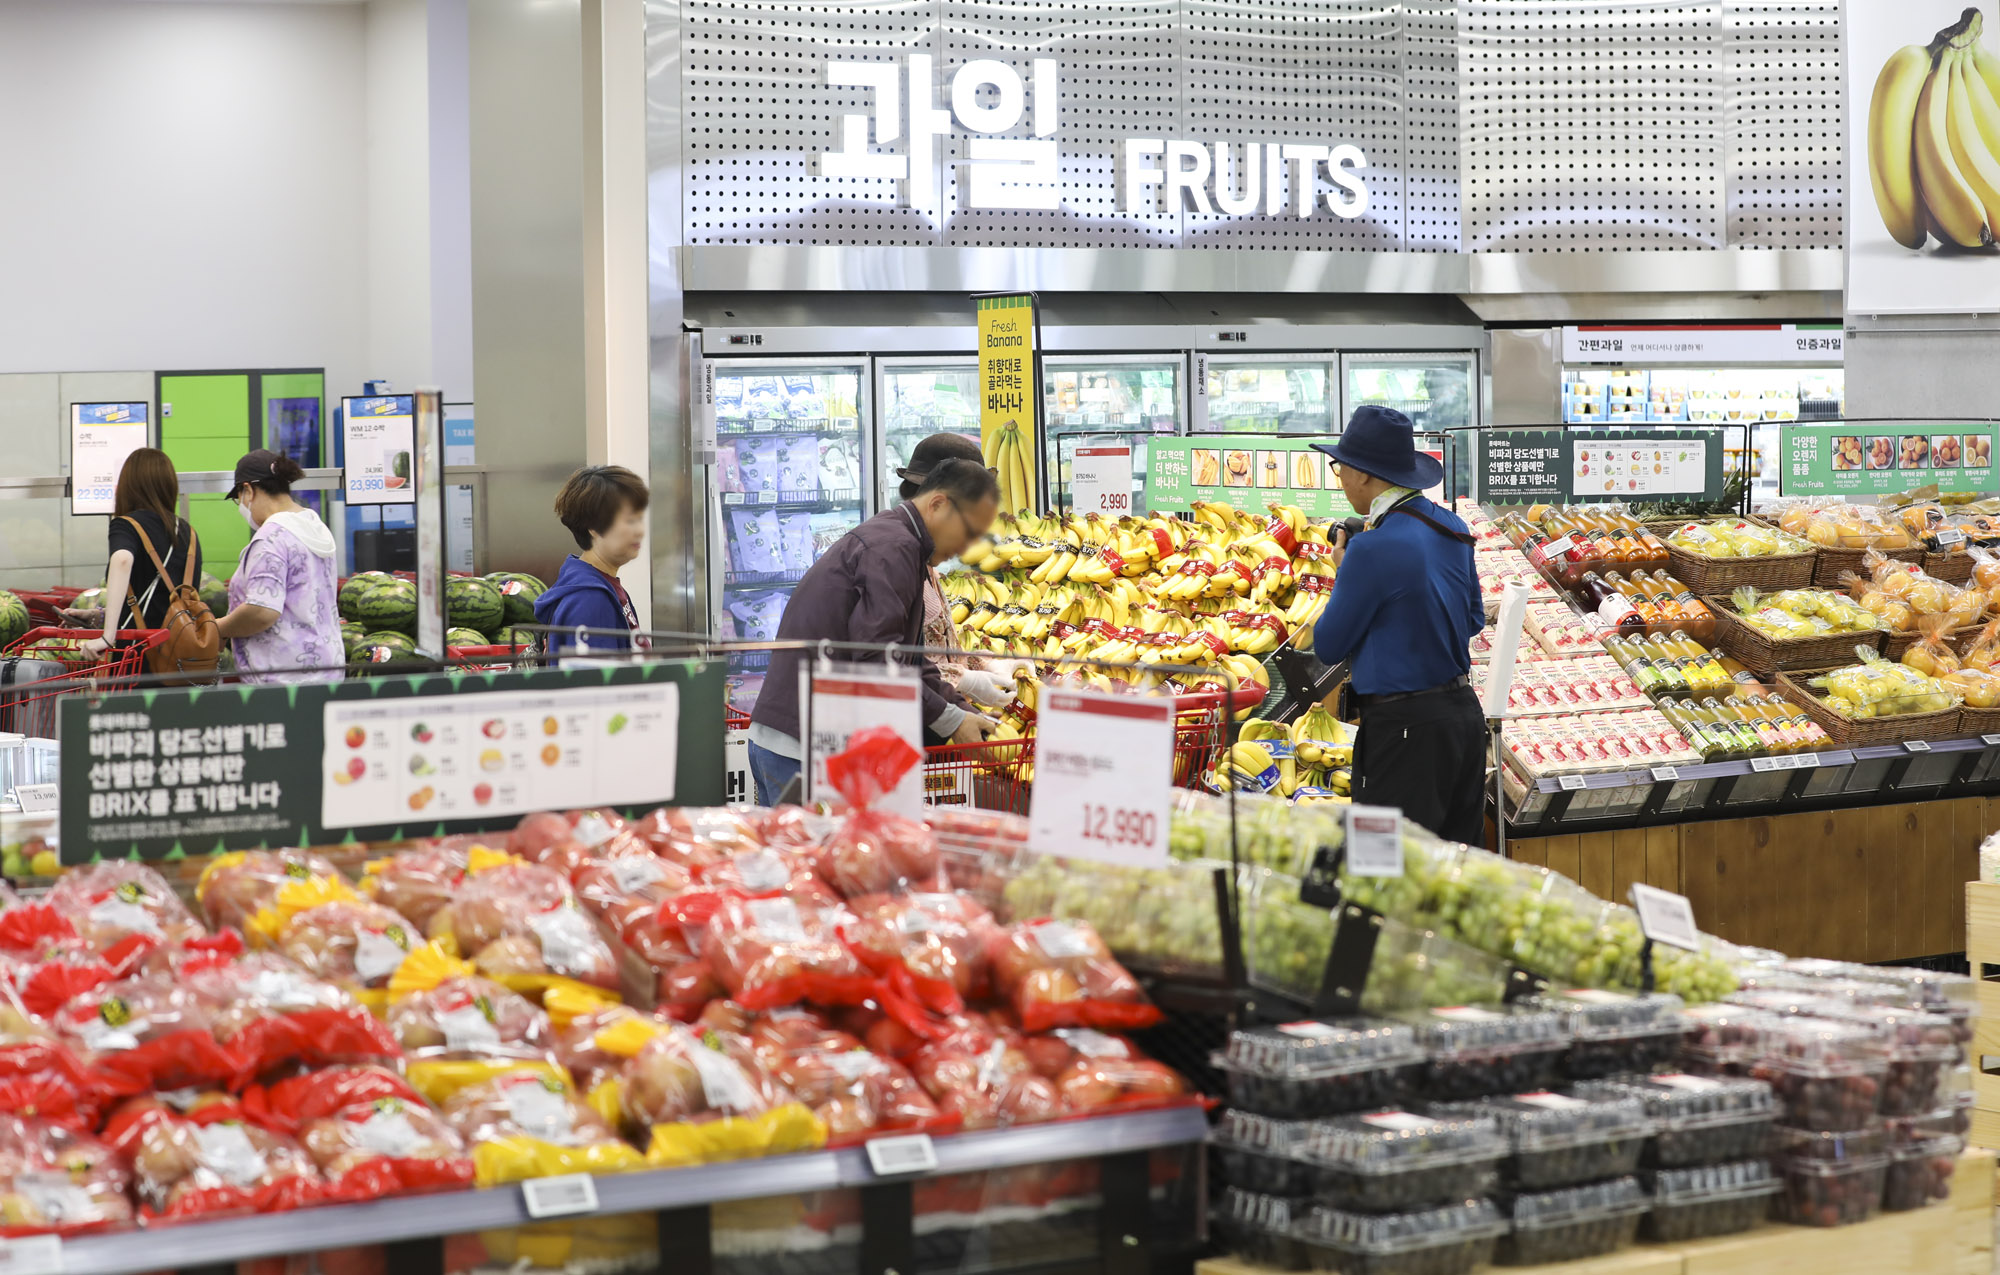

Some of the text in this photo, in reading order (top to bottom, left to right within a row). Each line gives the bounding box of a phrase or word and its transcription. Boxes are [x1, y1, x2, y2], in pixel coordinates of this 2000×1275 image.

[820, 54, 1060, 210] 과일
[1122, 138, 1369, 219] FRUITS
[991, 317, 1018, 332] Fresh
[987, 334, 1023, 348] Banana
[1578, 339, 1623, 351] 간편과일
[1645, 343, 1673, 352] 어디서나
[1796, 338, 1841, 350] 인증과일
[988, 358, 1022, 374] 취향대로
[987, 374, 1022, 391] 골라먹는
[987, 392, 1023, 414] 바나나
[1792, 436, 1818, 449] 다양한
[1489, 448, 1560, 459] 비파괴 당도선별기로
[1792, 449, 1818, 462] 오렌지
[1156, 462, 1188, 475] 더 반하는
[1488, 461, 1545, 473] 선별한 상품에만
[1792, 464, 1810, 476] 품종
[350, 478, 384, 491] 23,990
[1156, 476, 1179, 489] 바나나
[1489, 474, 1558, 486] BRIX를 표기합니다
[1100, 493, 1128, 512] 2,990
[89, 723, 287, 760] 비파괴 당도선별기로
[88, 753, 246, 790] 선별한 상품에만
[89, 780, 282, 818] BRIX를 표기합니다
[1081, 802, 1157, 849] 12,990
